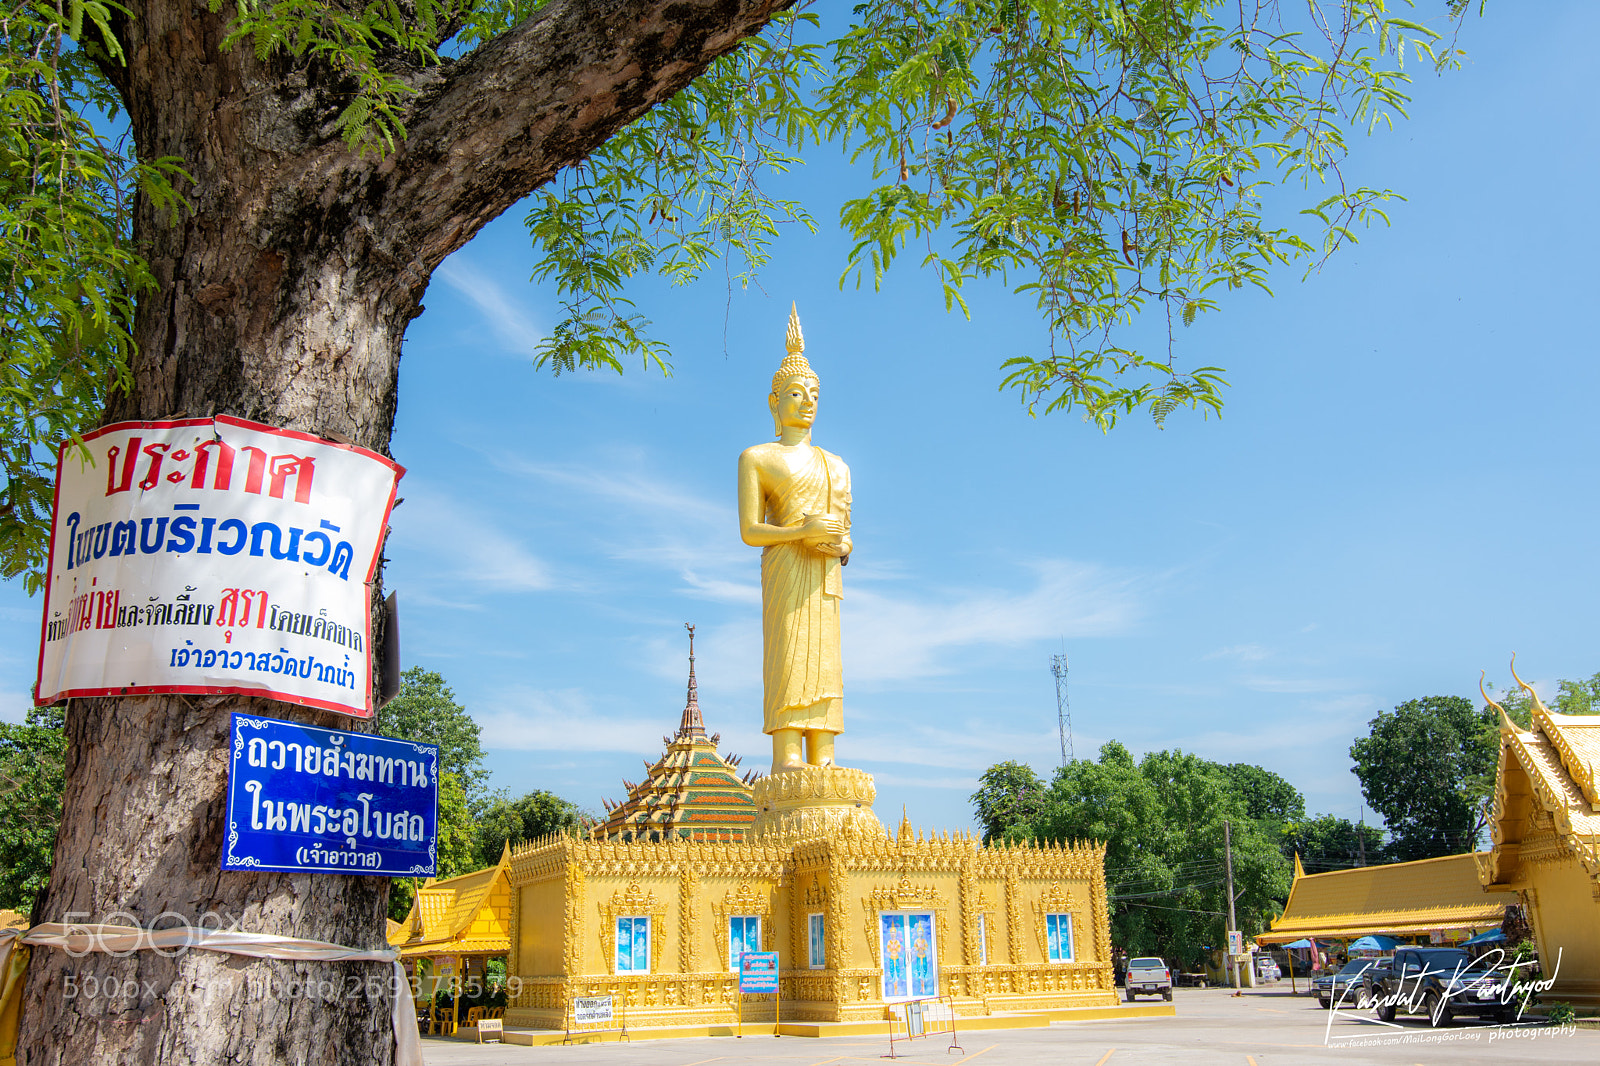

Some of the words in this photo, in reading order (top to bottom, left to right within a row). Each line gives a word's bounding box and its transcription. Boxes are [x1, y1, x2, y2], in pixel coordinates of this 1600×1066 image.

[105, 437, 316, 504] ประกาศ
[170, 640, 355, 690] เจ้าอาวาสวัดปากน้ำ
[247, 735, 428, 788] ถวายสังฆทาน
[244, 780, 424, 849] ในพระอุโบสถ
[296, 843, 382, 869] (เจ้าอาวาส)
